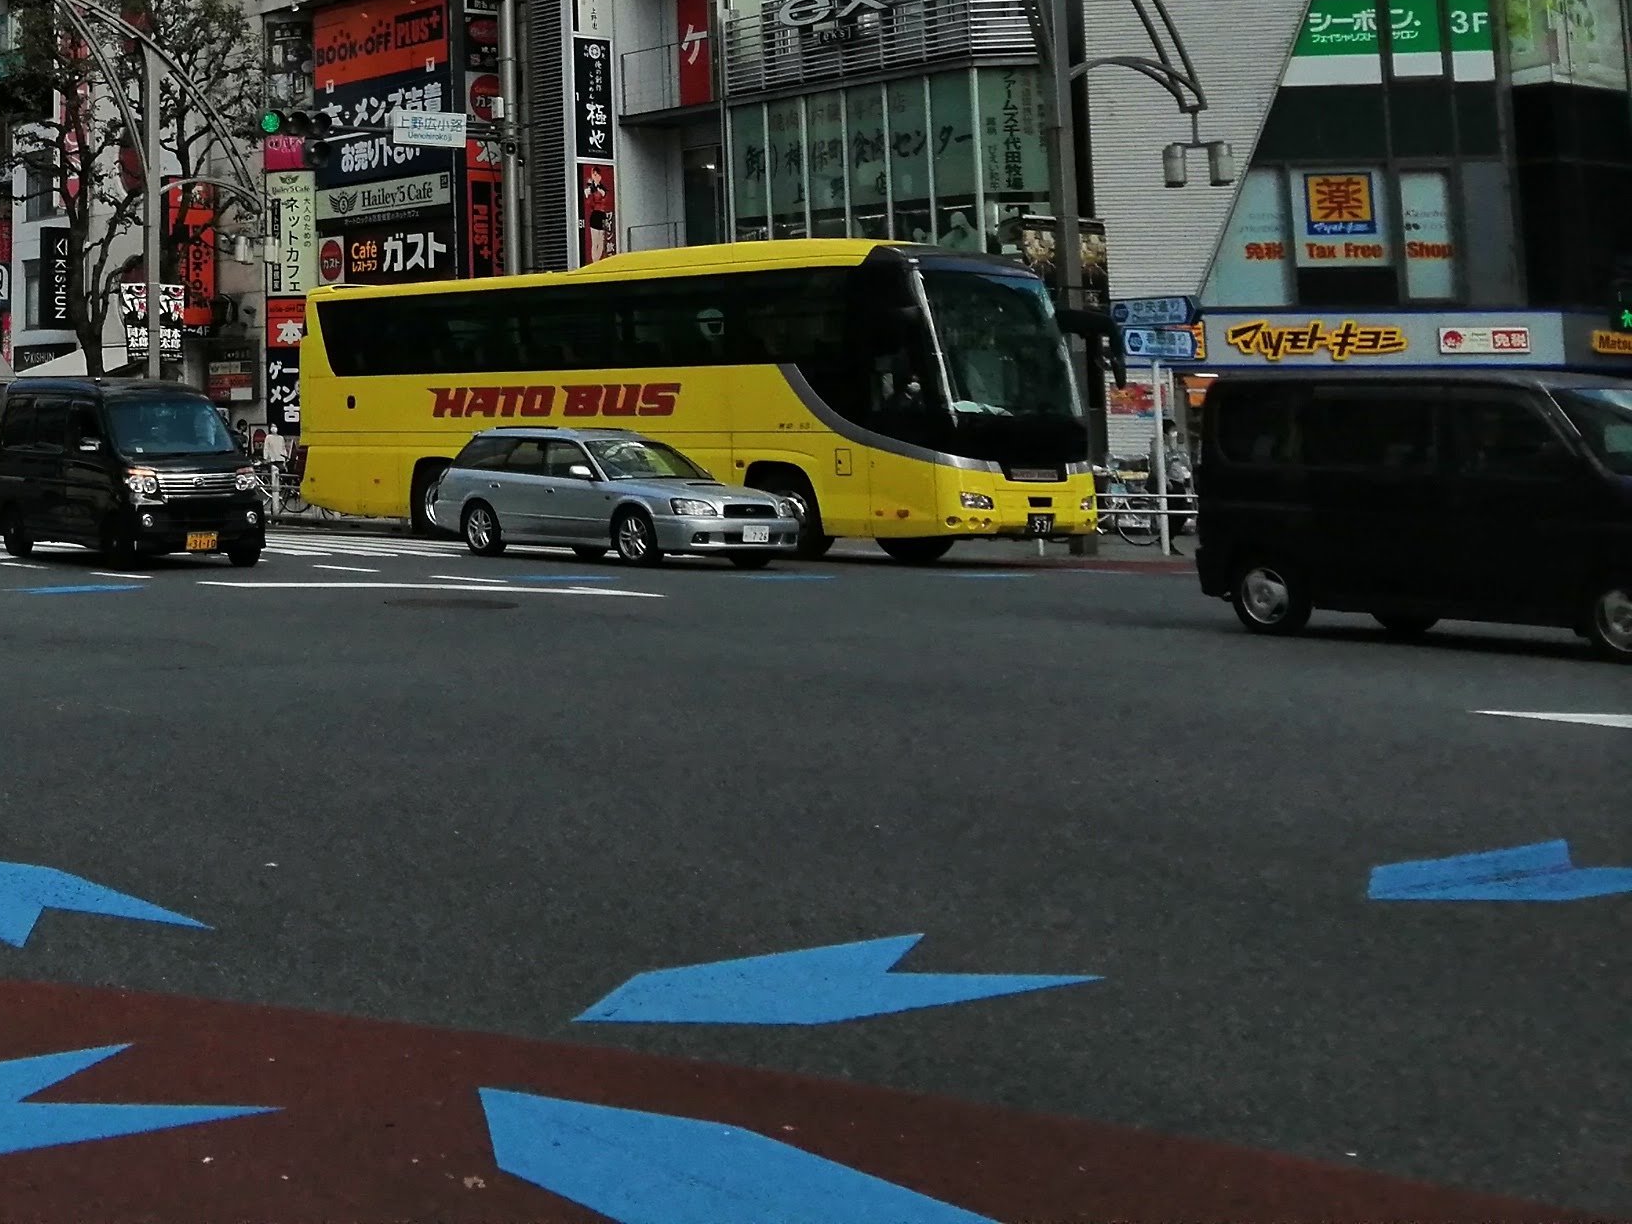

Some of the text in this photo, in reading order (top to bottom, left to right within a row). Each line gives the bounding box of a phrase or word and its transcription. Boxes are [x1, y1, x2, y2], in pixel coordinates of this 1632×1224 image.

[1451, 9, 1489, 34] 3F
[475, 95, 494, 108] ガス
[400, 116, 463, 133] 上野広小路
[407, 181, 434, 200] Café
[1315, 177, 1363, 220] 薬
[303, 198, 312, 248] 大人のための
[1311, 221, 1369, 235] マツモトキヨシ
[285, 197, 301, 292] ネットカフェ
[351, 242, 378, 260] Café
[382, 232, 447, 273] ガスト
[1244, 242, 1285, 260] 免税
[1305, 240, 1455, 261] Tax Free Shop
[323, 257, 340, 269] ガスト
[54, 259, 67, 319] KISHUN
[276, 320, 302, 345] 本
[1226, 319, 1408, 362] マツモトキヨシ
[1492, 330, 1528, 350] 免税
[269, 361, 300, 380] ゲー
[270, 386, 300, 404] メン
[428, 382, 682, 418] HATO BUS
